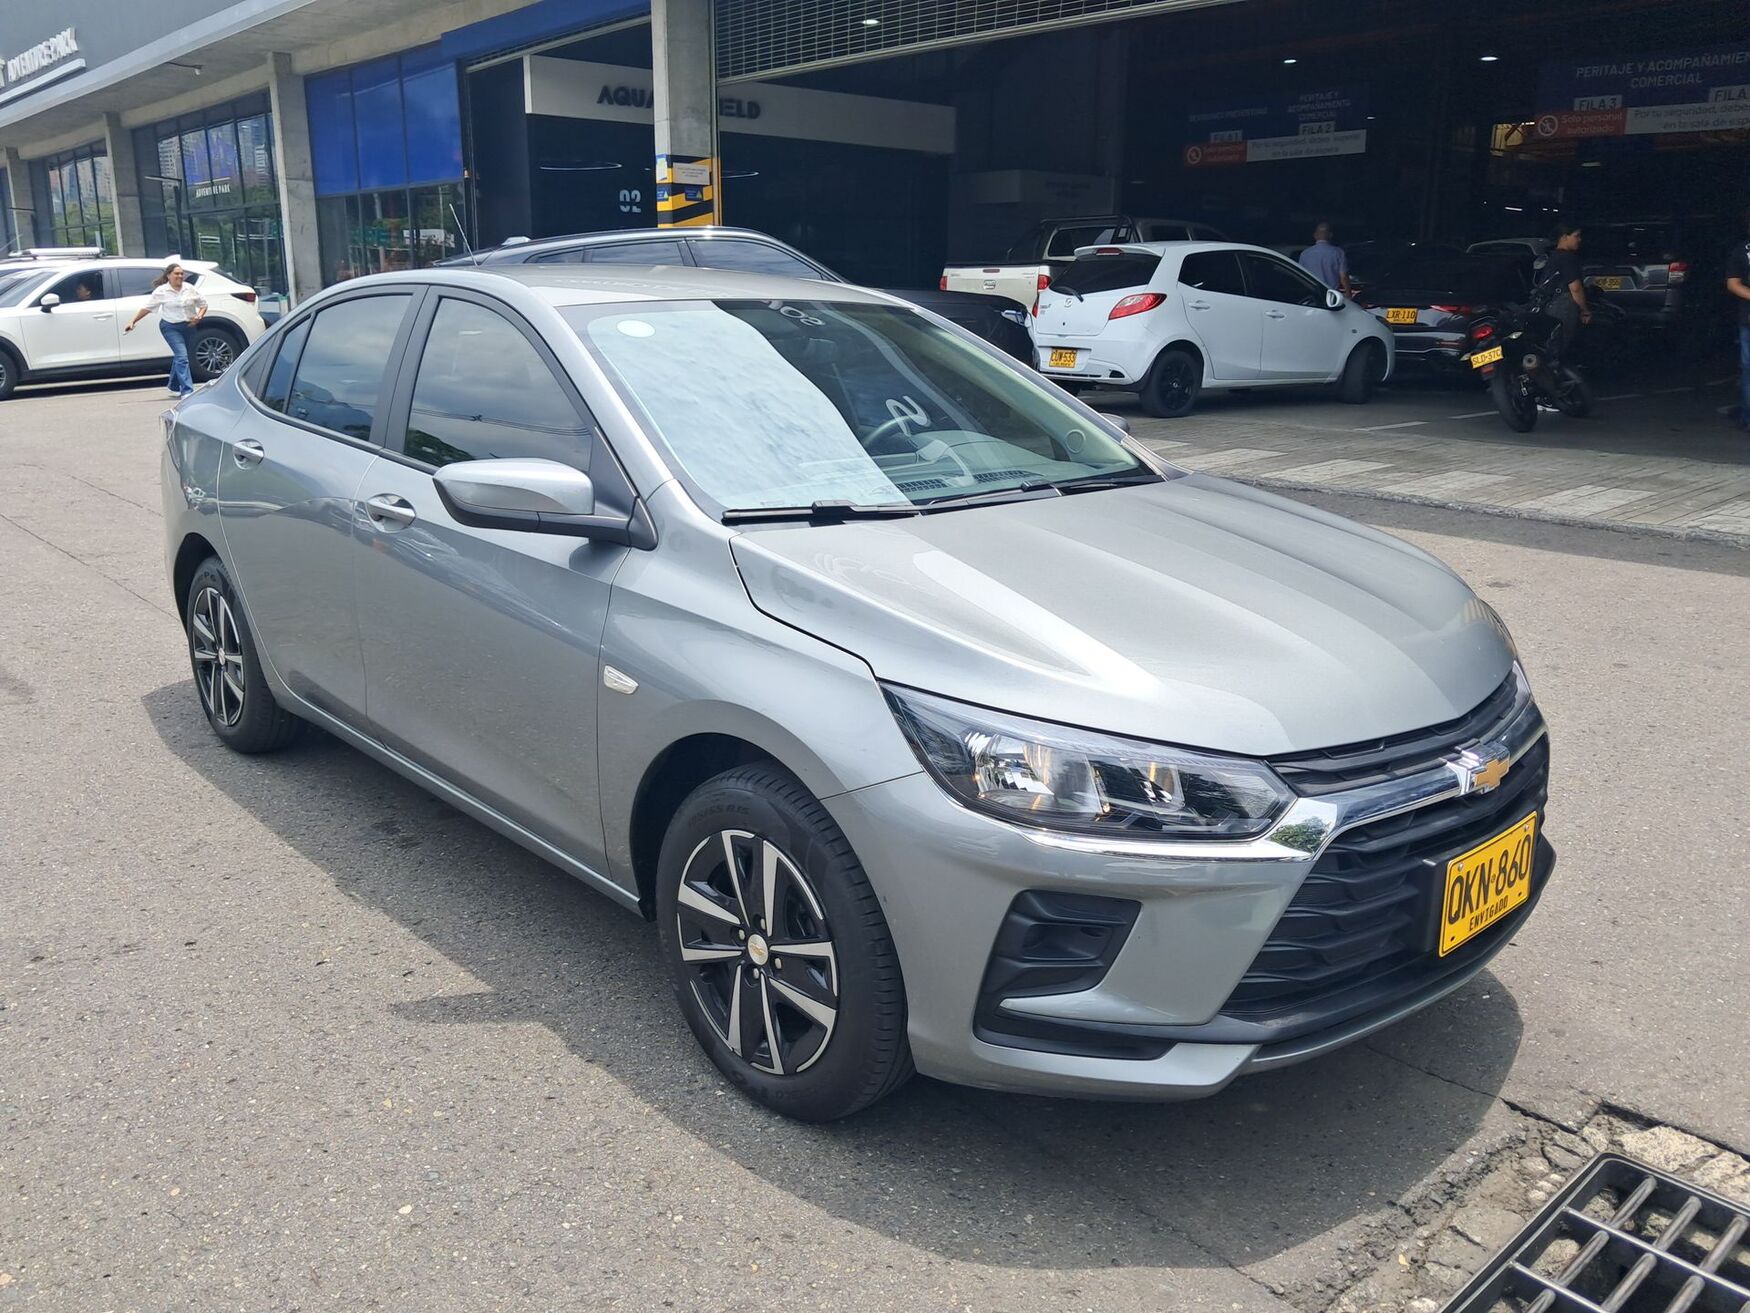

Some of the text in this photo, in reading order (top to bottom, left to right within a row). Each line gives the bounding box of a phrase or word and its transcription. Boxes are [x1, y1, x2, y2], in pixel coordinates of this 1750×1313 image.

[50, 27, 78, 61] PARK
[1576, 63, 1633, 80] PERITAJE
[1636, 62, 1645, 73] Y
[1631, 72, 1703, 88] COMERCIAL
[1715, 88, 1746, 102] FILA
[1580, 98, 1606, 111] FILA
[1303, 124, 1325, 135] FILA
[619, 189, 642, 213] 02
[1468, 895, 1509, 932] ENVIGADO
